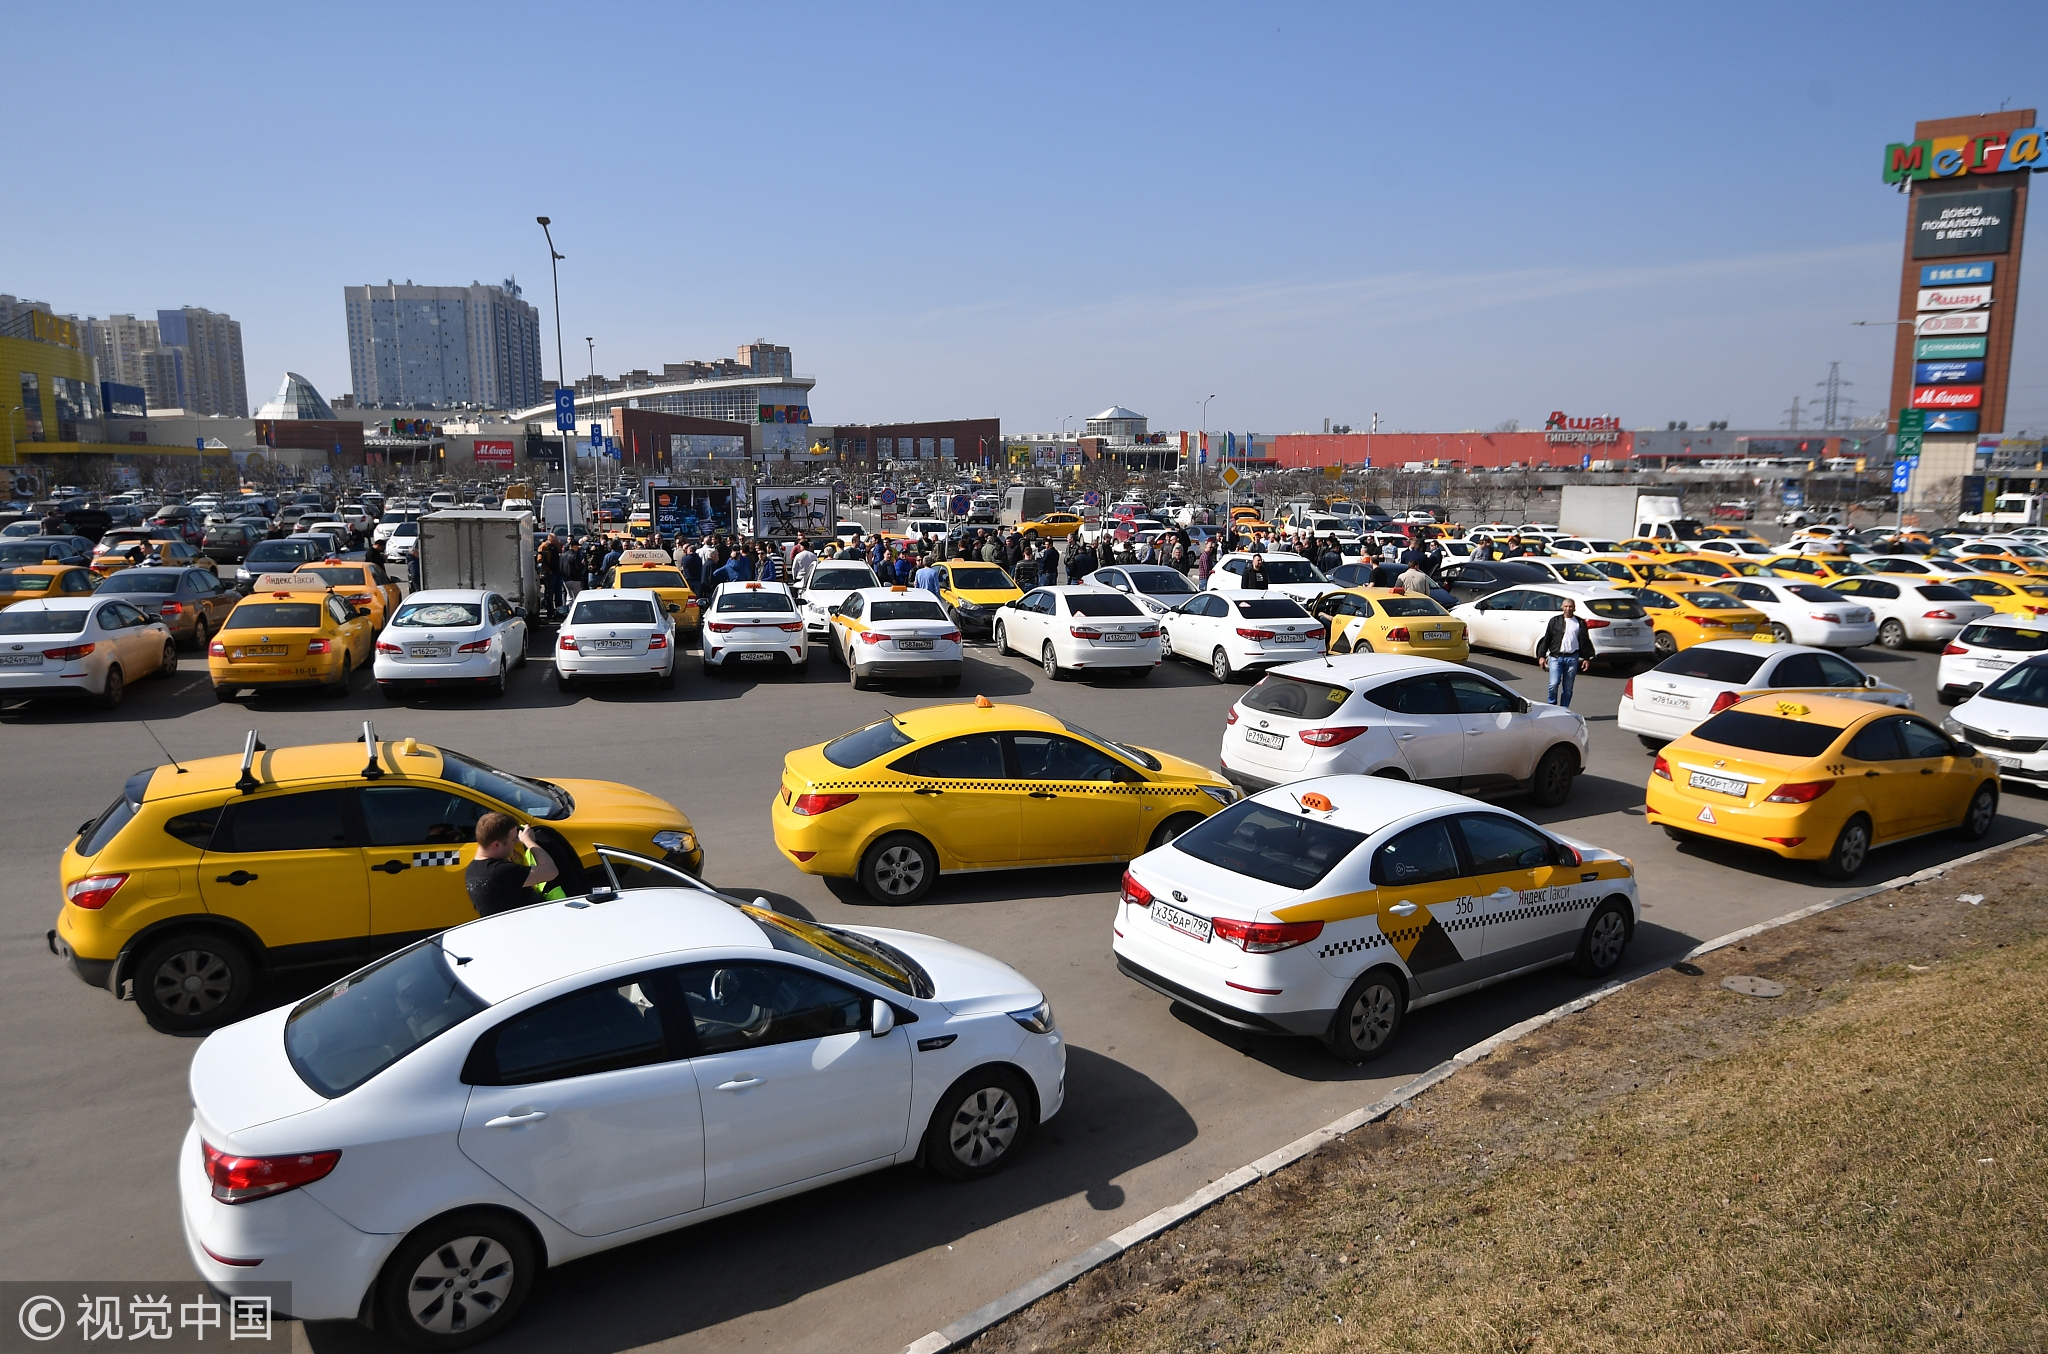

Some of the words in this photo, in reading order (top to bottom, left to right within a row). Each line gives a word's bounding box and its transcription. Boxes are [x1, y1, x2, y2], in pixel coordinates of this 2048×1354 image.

[1940, 206, 1982, 220] ДОБРО
[1921, 216, 2000, 231] ПОЖАЛОВАТЬ
[1936, 230, 1945, 240] В
[1946, 227, 1983, 239] МЕГУ!
[1929, 267, 1983, 280] IKEA
[1925, 317, 1980, 331] OBI
[559, 412, 573, 424] 10
[1545, 411, 1621, 430] Ашан
[1545, 432, 1619, 442] ГИПЕРМАРКЕТ
[1893, 477, 1907, 488] 14
[629, 551, 648, 559] Яндекс
[650, 551, 664, 559] Такси
[265, 575, 292, 585] Яндекс
[294, 575, 315, 584] Такси
[1518, 888, 1547, 906] Яндекс
[1548, 884, 1571, 900] Такси
[1455, 896, 1474, 915] 356
